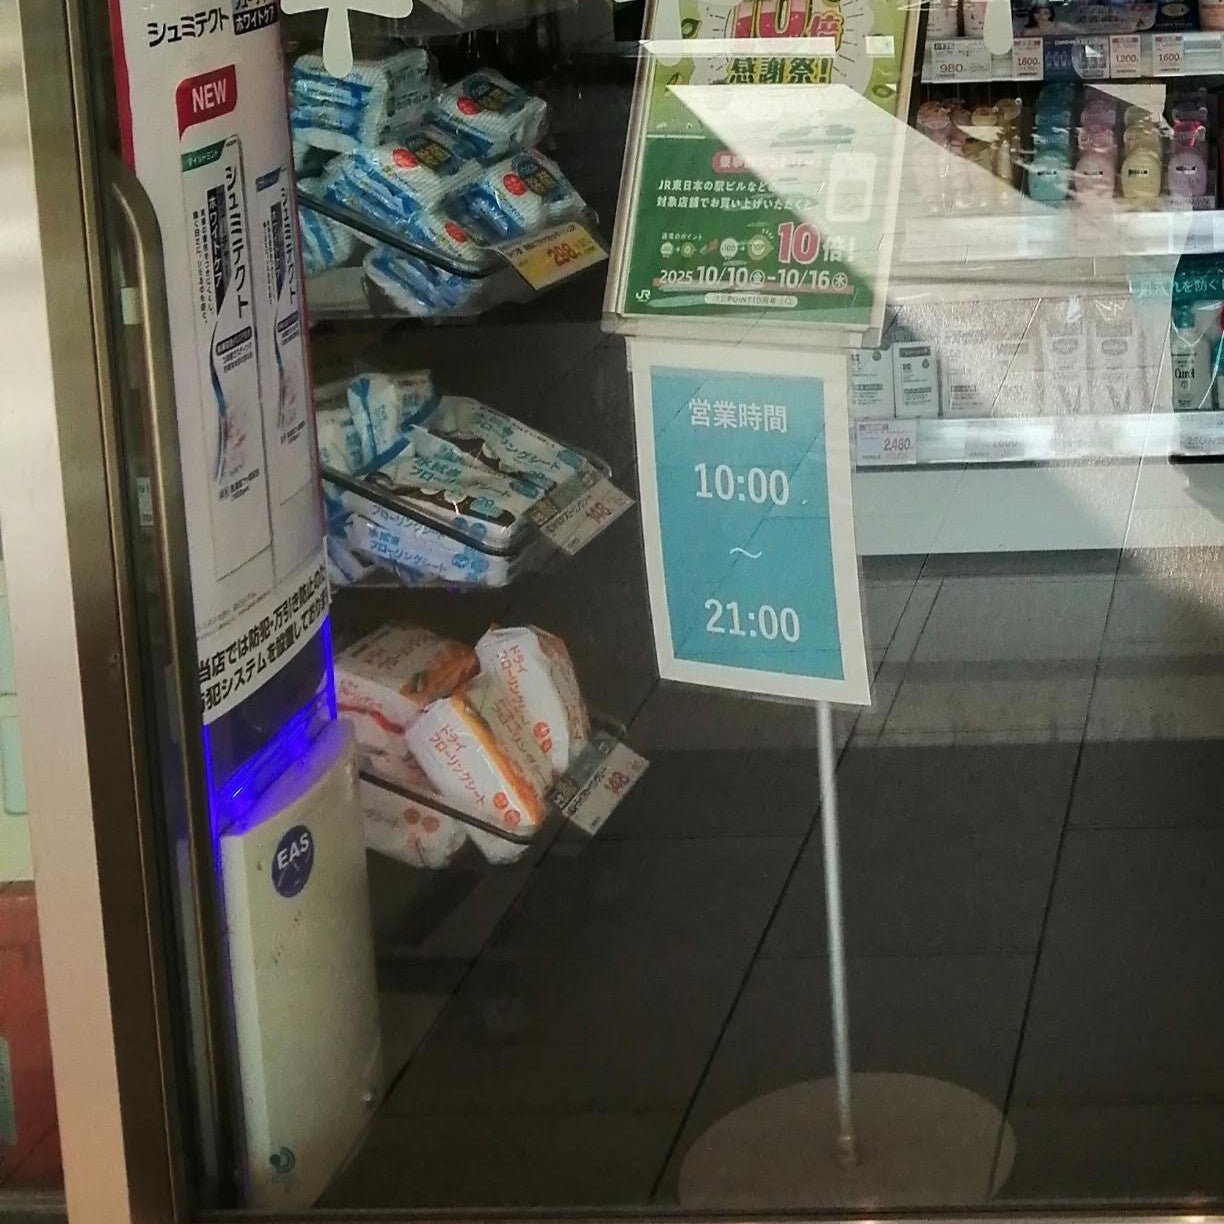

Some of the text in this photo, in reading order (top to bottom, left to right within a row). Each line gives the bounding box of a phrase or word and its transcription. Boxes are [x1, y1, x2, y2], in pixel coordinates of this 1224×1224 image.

[147, 7, 230, 47] シュミテクト
[234, 5, 277, 32] ホワイトケア
[731, 55, 830, 85] 感謝祭!
[939, 63, 964, 74] 980
[191, 77, 228, 114] NEW
[225, 165, 249, 319] シュミテクト
[635, 289, 651, 300] JR
[659, 269, 694, 285] 2025
[688, 397, 789, 433] 営業時間
[693, 461, 791, 506] 10:00
[703, 597, 801, 644] 21:00
[277, 832, 310, 870] EAS
